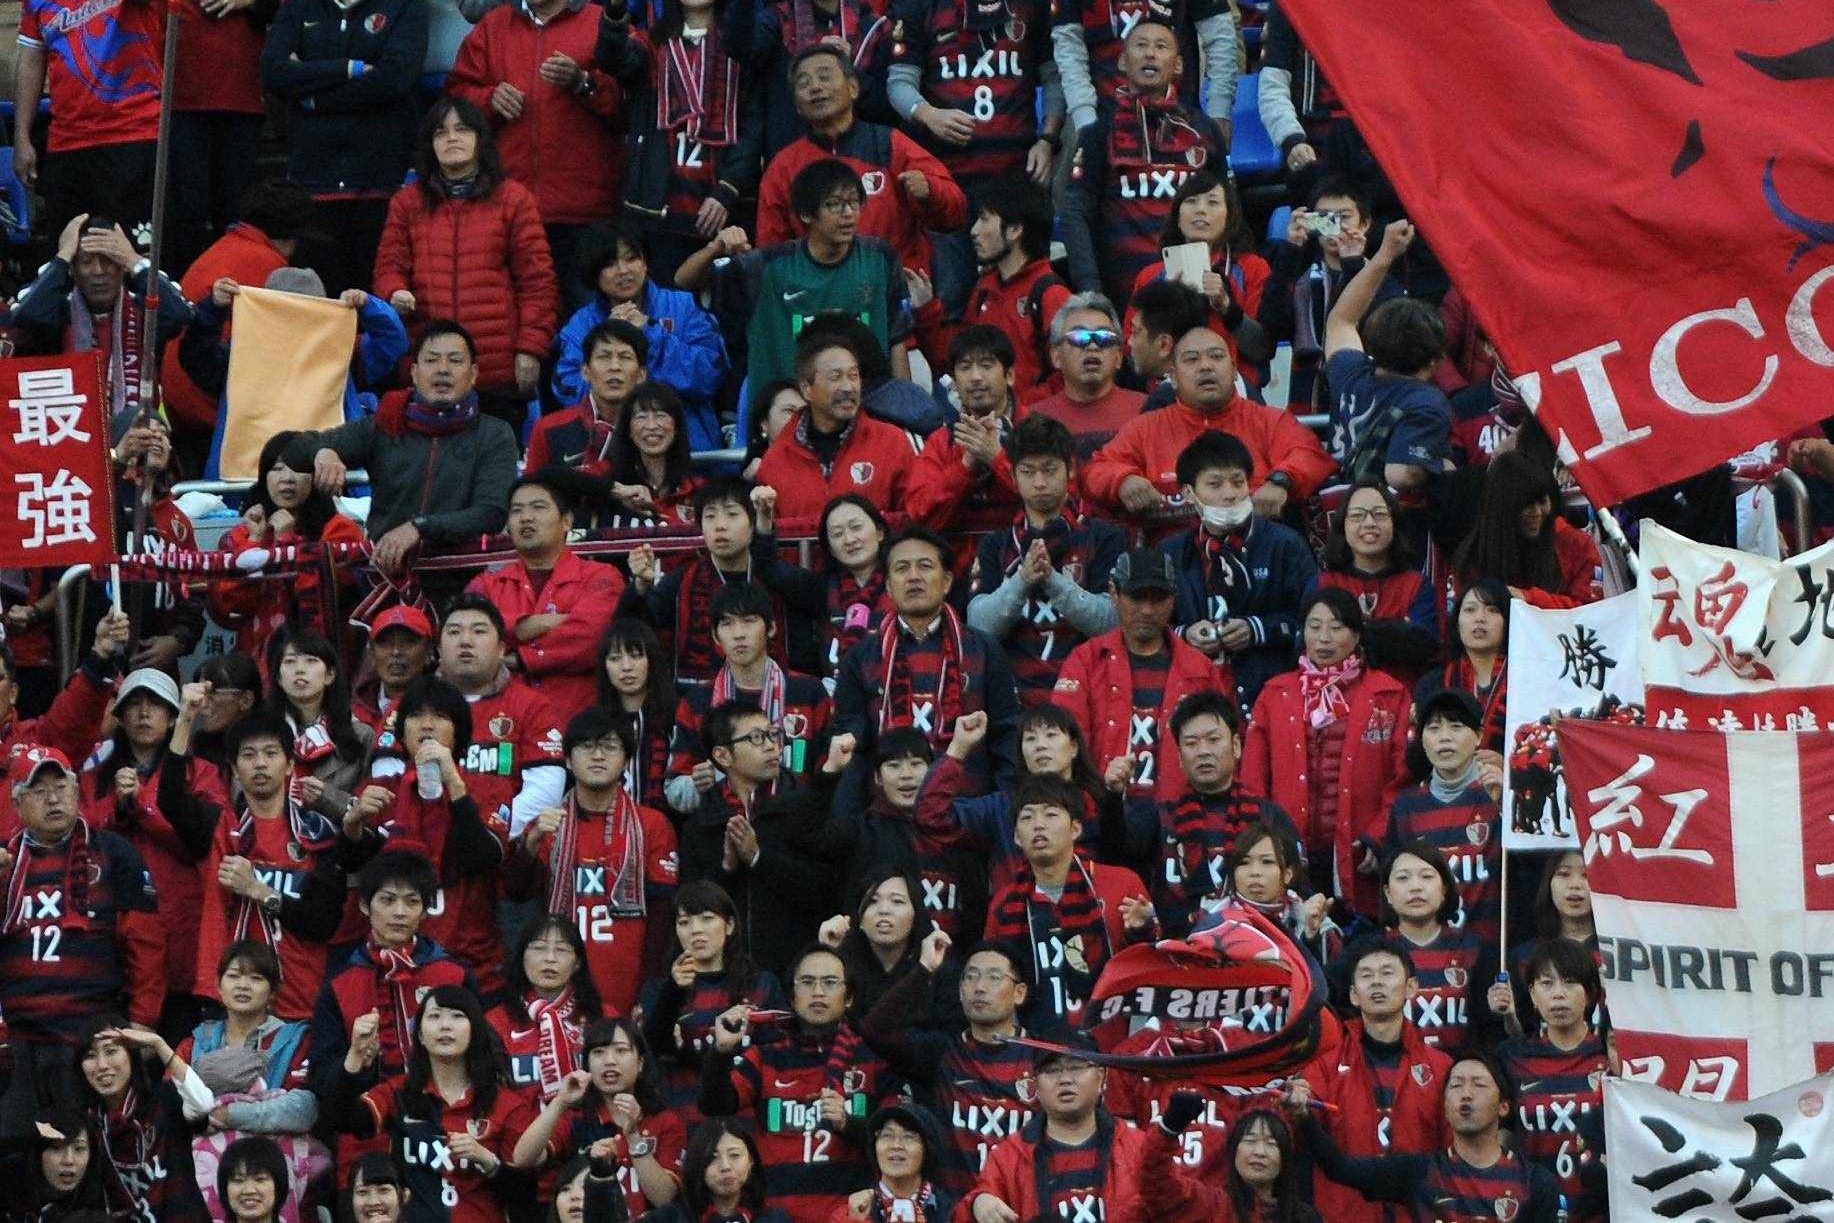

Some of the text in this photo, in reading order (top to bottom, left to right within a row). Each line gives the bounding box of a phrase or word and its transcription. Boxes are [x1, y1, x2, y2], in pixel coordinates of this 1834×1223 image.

[939, 49, 1023, 80] LIXIL
[973, 84, 996, 122] 8
[675, 132, 704, 167] 12
[9, 367, 97, 549] 最強
[1039, 629, 1054, 662] 7
[577, 905, 614, 942] 12
[31, 925, 61, 962] 12
[803, 1129, 832, 1164] 12
[1556, 1141, 1575, 1179] 6
